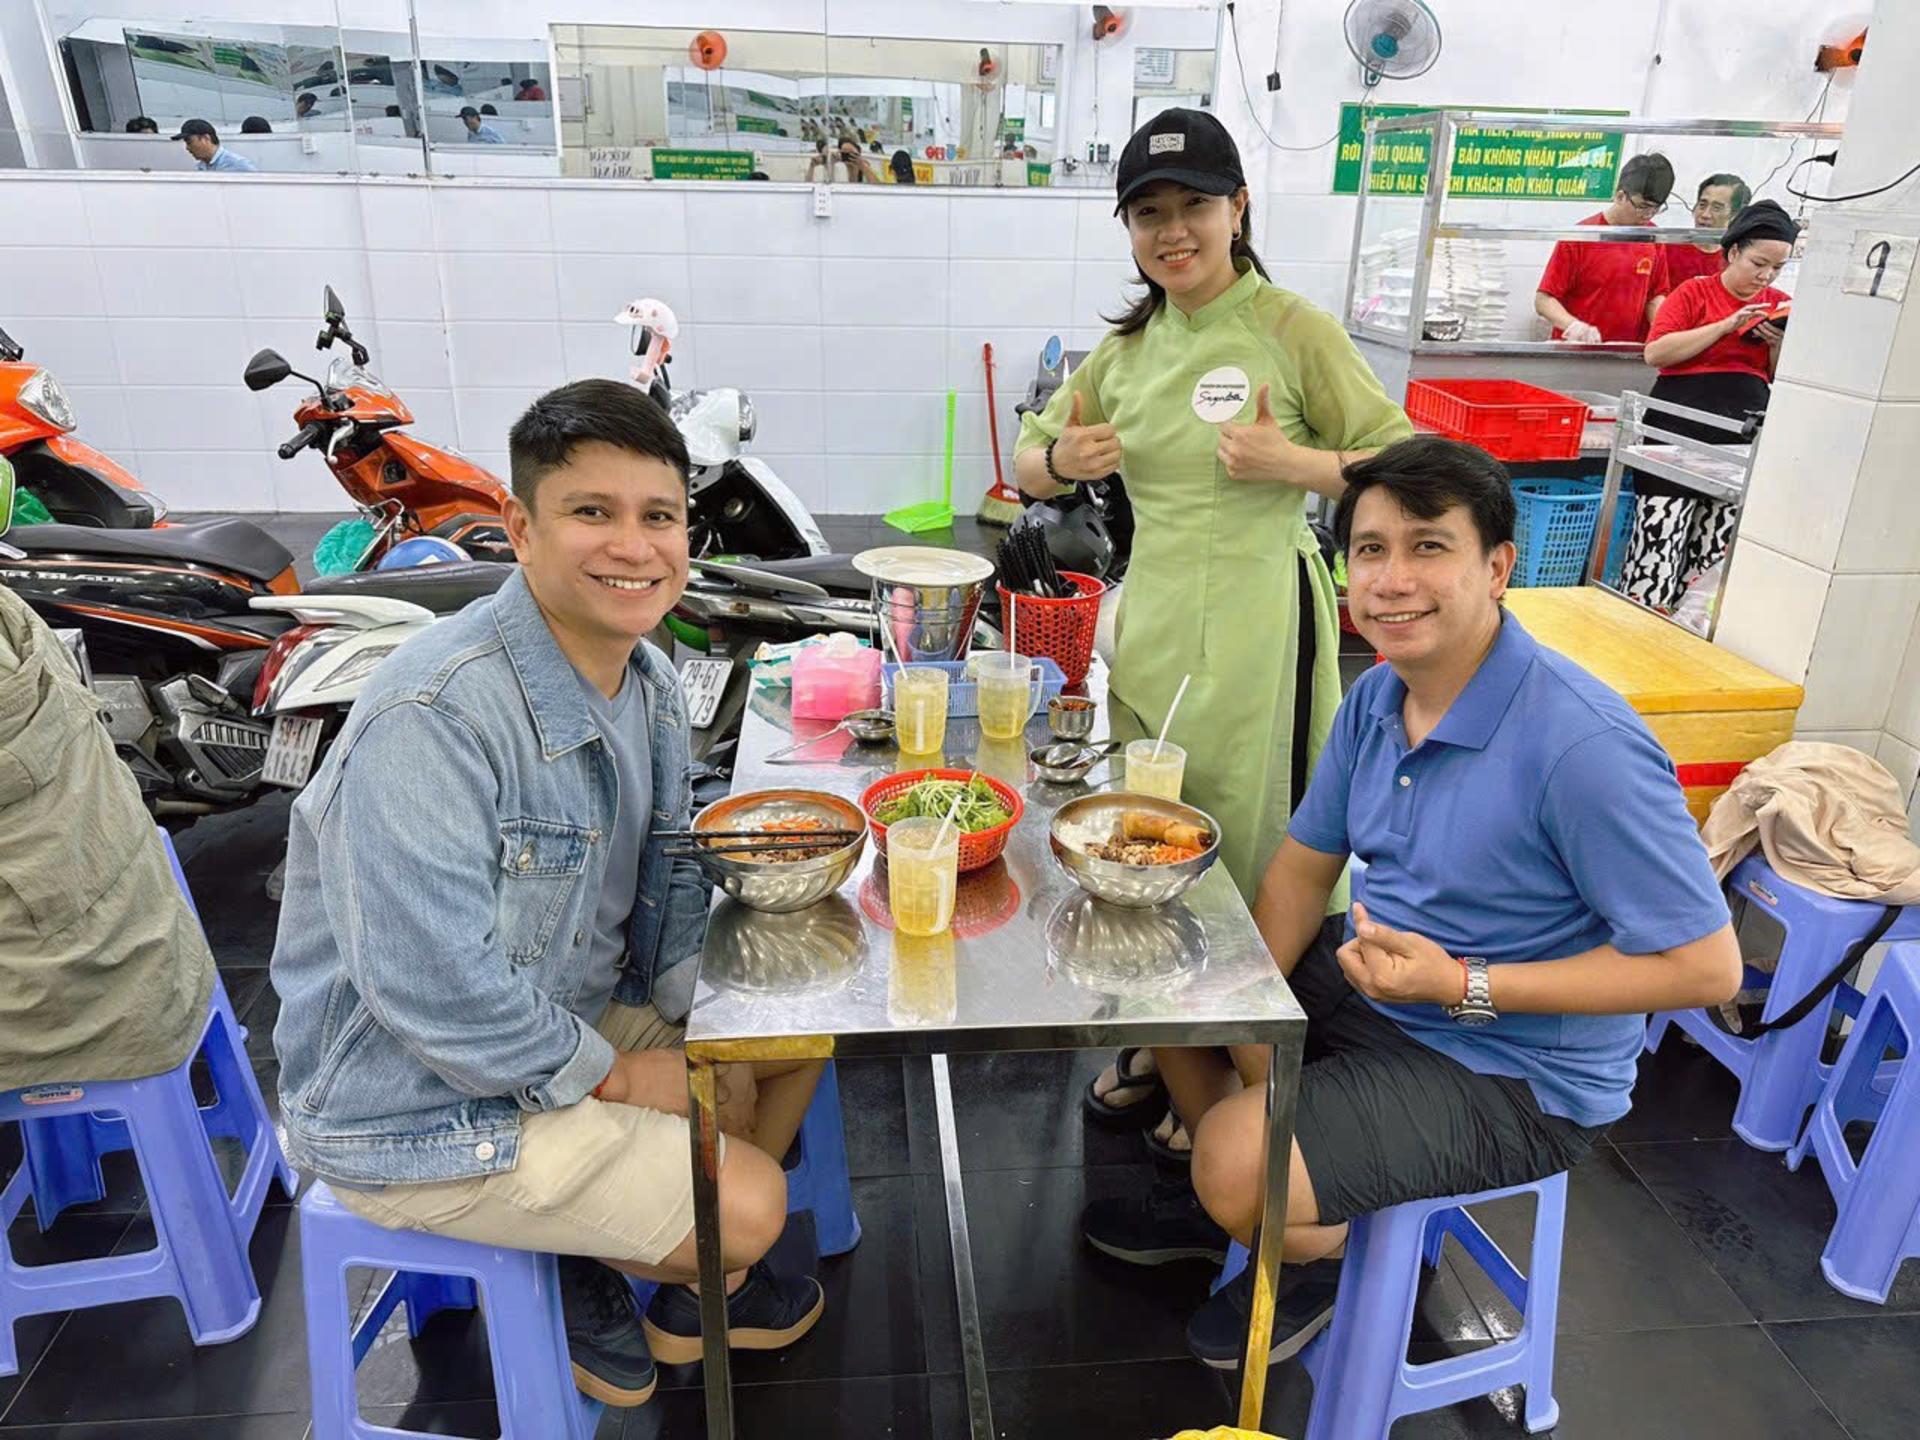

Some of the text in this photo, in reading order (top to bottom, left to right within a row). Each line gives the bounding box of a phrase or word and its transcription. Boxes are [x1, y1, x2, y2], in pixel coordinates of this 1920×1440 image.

[1342, 140, 1361, 161] RỜI
[1371, 139, 1390, 161] HỎI
[1458, 142, 1480, 164] BẢO
[1483, 145, 1522, 165] KHÔNG
[1523, 146, 1556, 169] NHẬN
[1369, 168, 1395, 190] HIẾU
[1397, 174, 1418, 194] NẠI
[1466, 172, 1505, 192] KHÁCH
[1506, 173, 1525, 193] RỜI
[1527, 172, 1554, 194] KHỎI
[1866, 240, 1891, 296] 9
